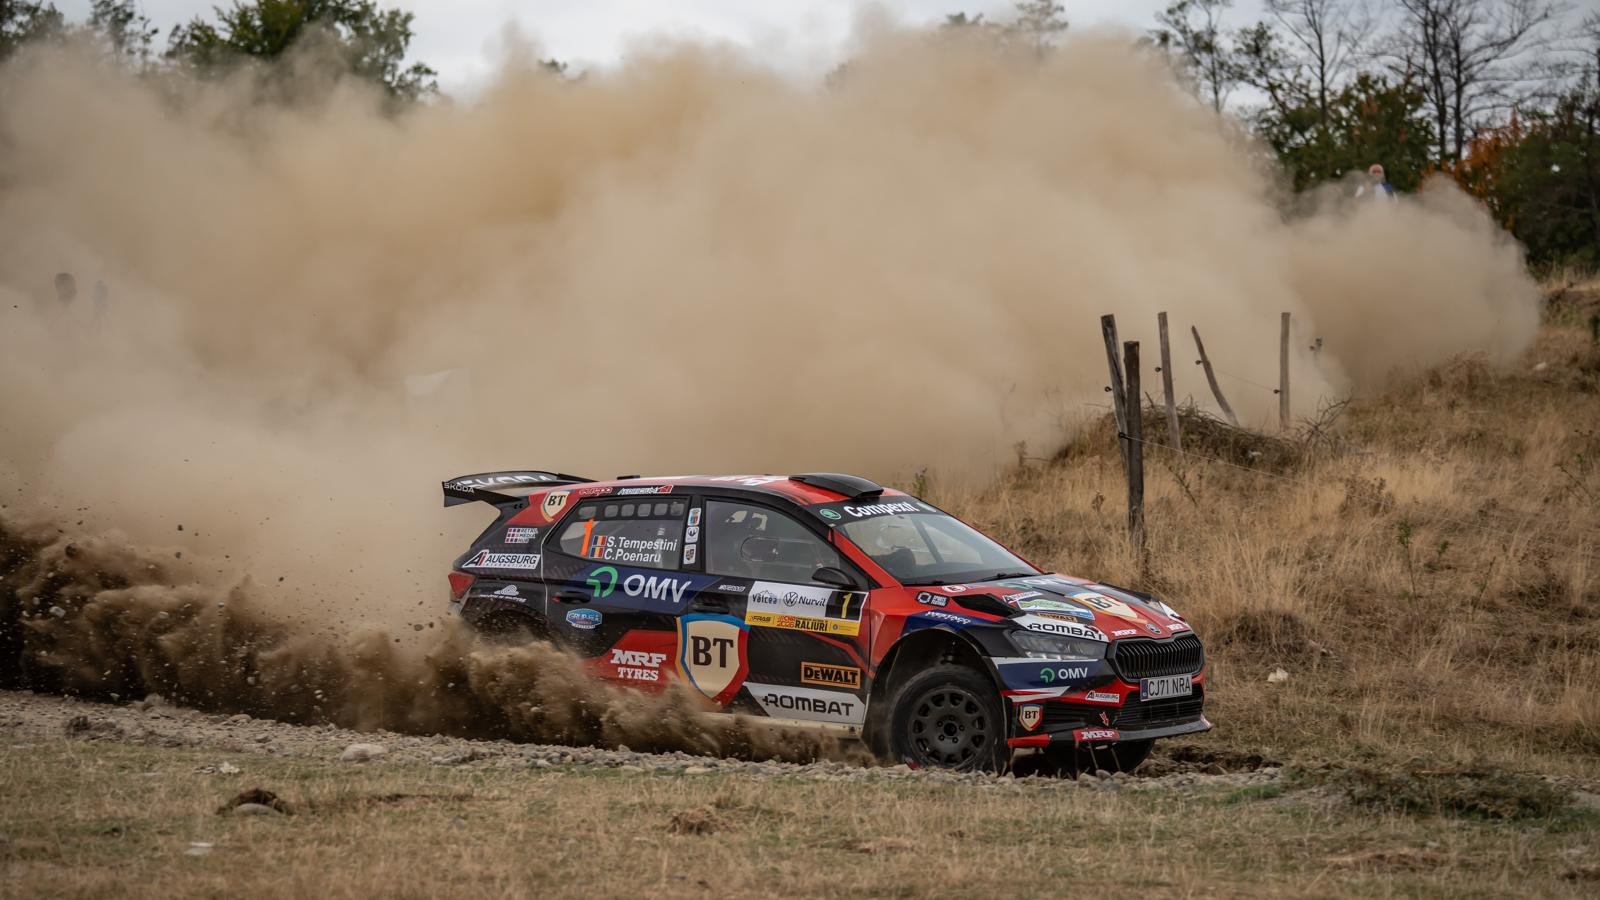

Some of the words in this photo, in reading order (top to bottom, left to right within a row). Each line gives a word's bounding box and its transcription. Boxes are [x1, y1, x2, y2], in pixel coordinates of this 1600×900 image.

[547, 494, 566, 507] BT
[580, 516, 595, 557] 1
[486, 554, 538, 565] AUGSBURG
[623, 574, 692, 603] OMV
[799, 596, 826, 607] Nurvil
[842, 592, 853, 619] 1
[610, 649, 667, 668] MRF
[691, 636, 734, 668] BT
[617, 667, 659, 681] TYRES
[1058, 668, 1088, 680] OMV
[1148, 680, 1169, 697] CJ71
[1172, 676, 1191, 694] NRA
[762, 693, 854, 717] ROMBAT
[1024, 710, 1039, 720] BT
[1081, 730, 1115, 740] MRF
